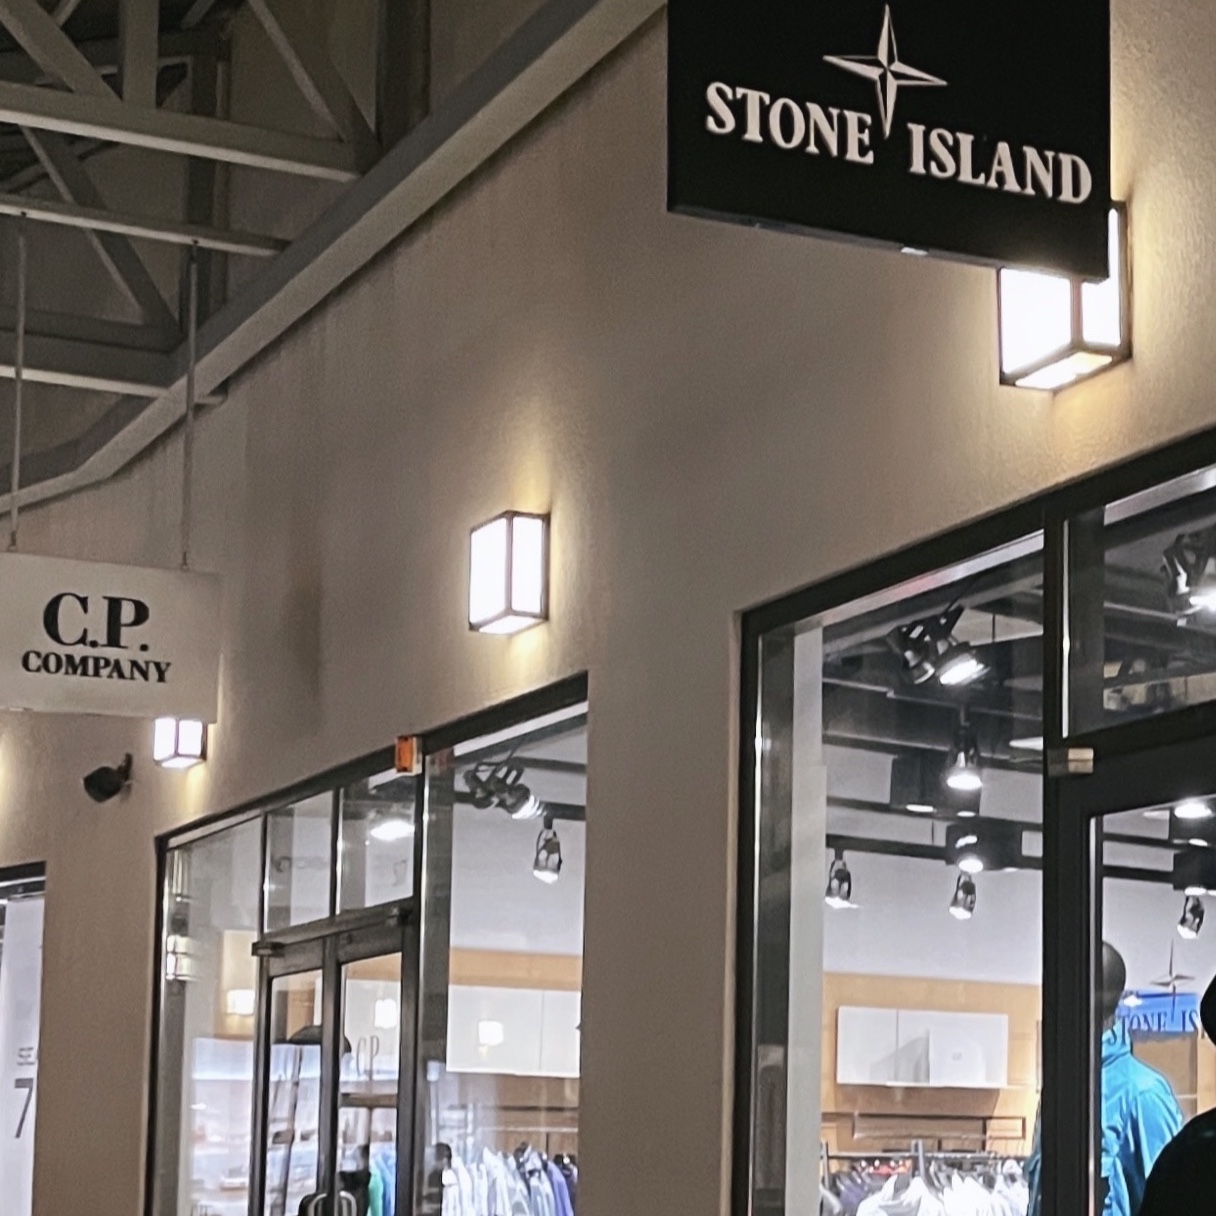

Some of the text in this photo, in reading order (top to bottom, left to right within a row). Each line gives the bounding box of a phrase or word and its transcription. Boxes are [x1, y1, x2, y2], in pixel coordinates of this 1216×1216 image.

[705, 81, 1093, 205] STONE ISLAND
[43, 592, 150, 651] C.P.
[21, 650, 171, 684] COMPANY
